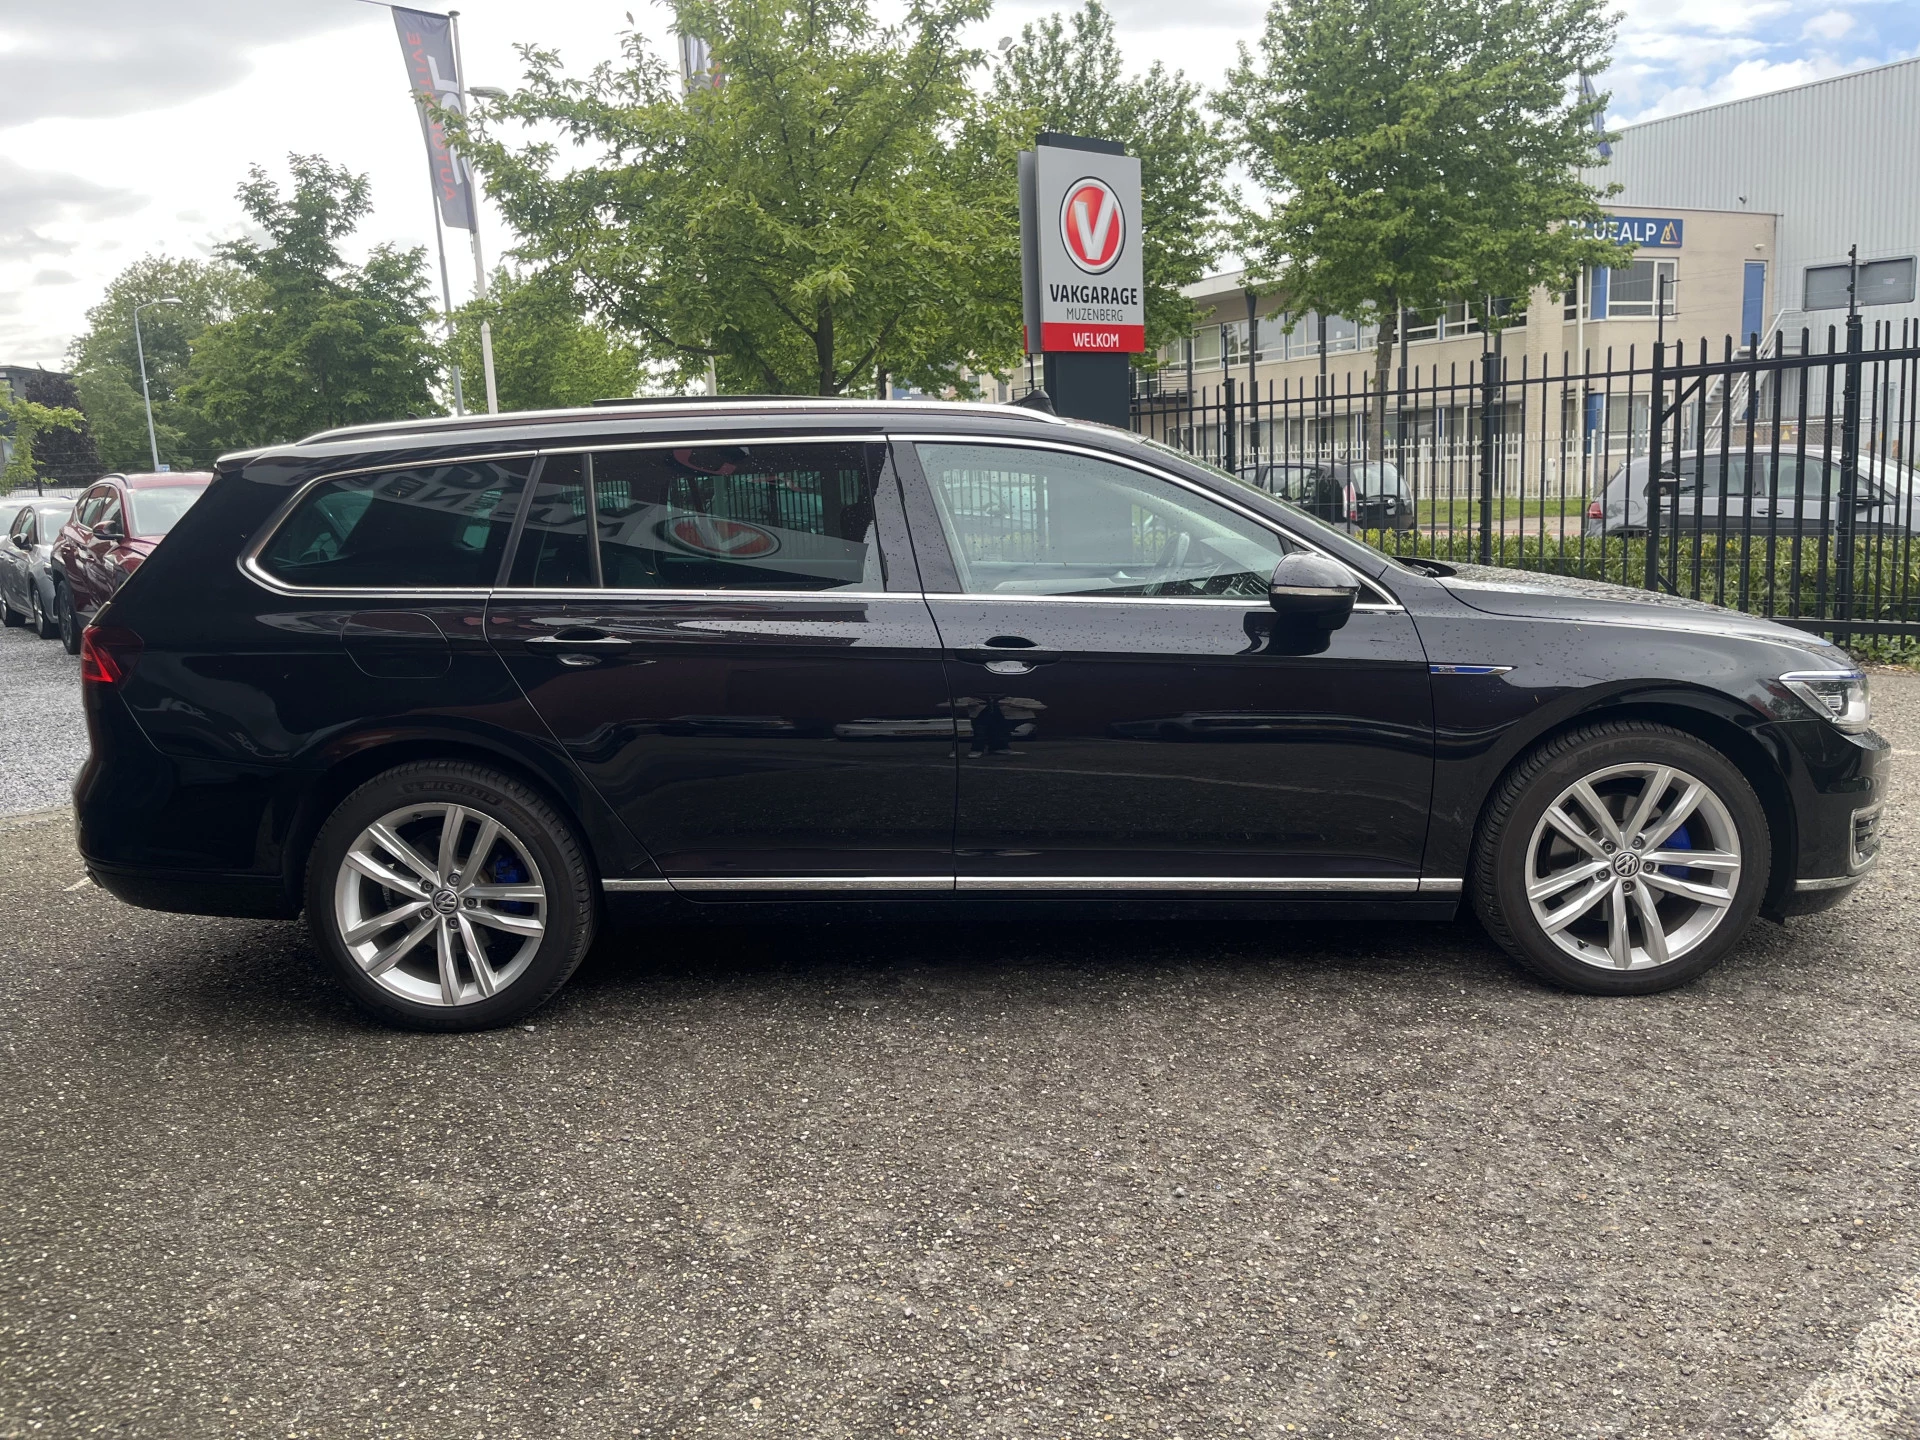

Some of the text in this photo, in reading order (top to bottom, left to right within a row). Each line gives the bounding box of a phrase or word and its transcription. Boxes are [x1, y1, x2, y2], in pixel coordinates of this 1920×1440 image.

[1049, 283, 1138, 306] VAKGARAGE
[1066, 307, 1123, 322] MUZENBERG
[1072, 332, 1119, 348] WELKOM
